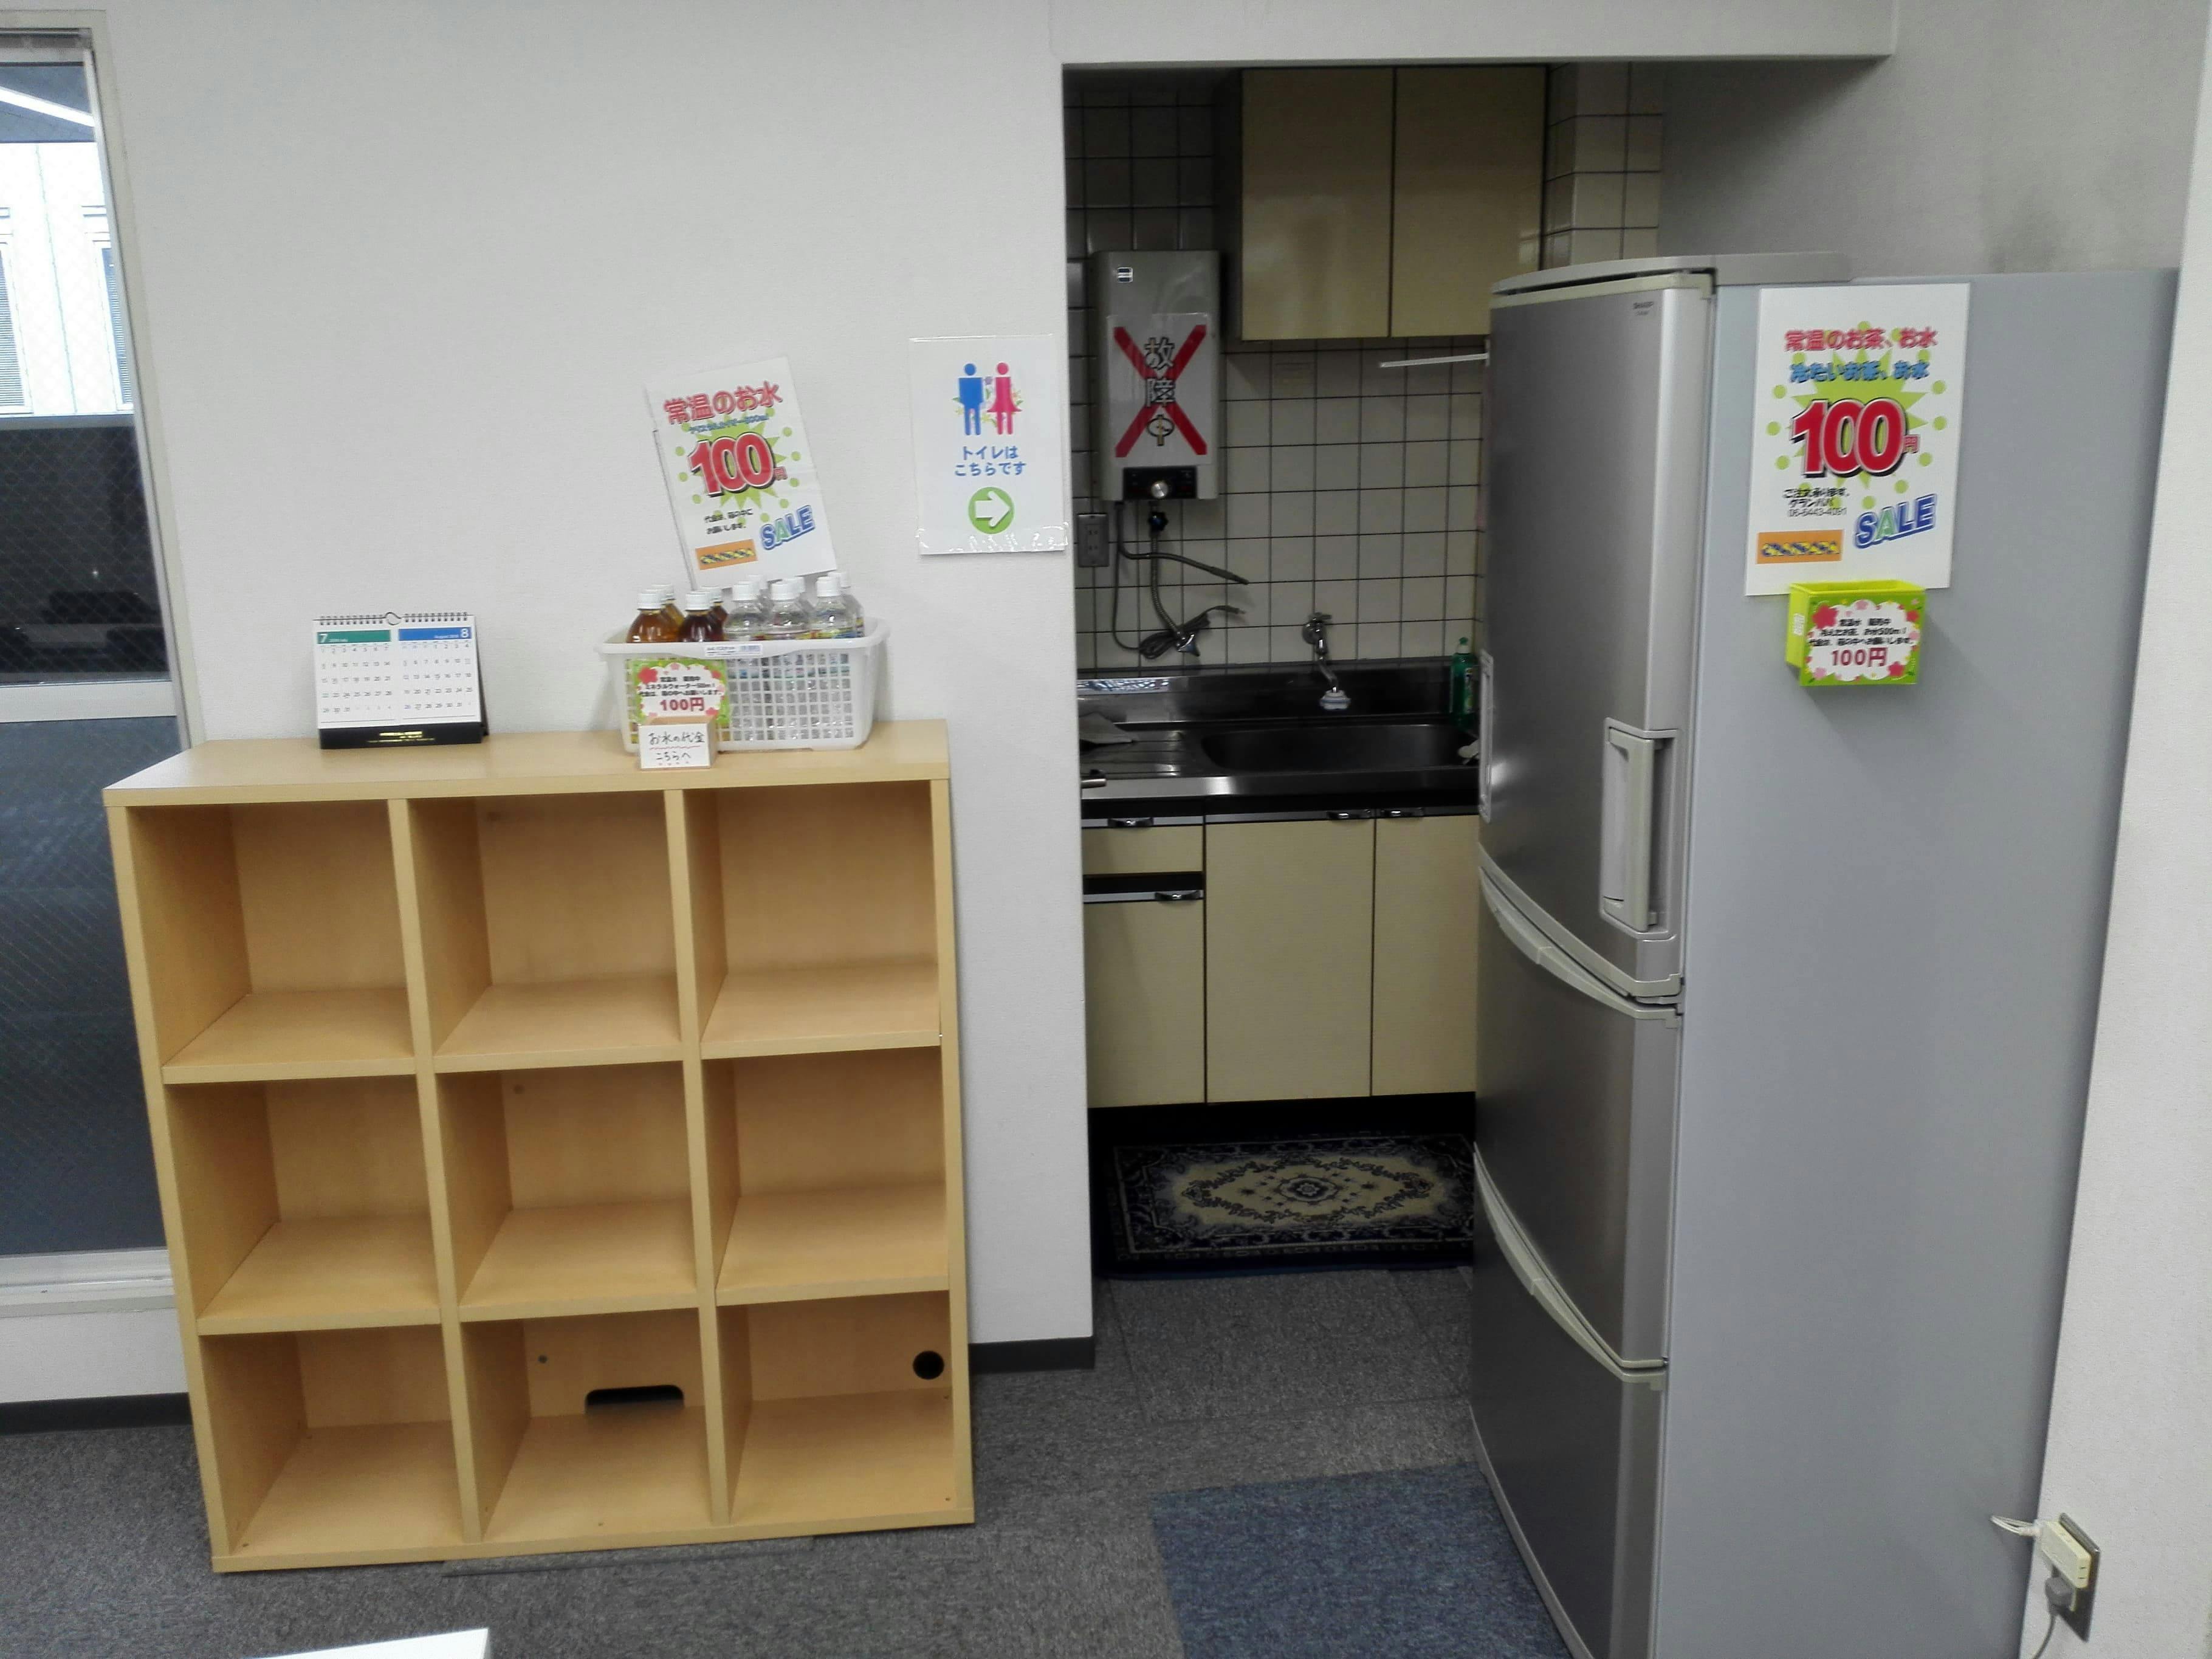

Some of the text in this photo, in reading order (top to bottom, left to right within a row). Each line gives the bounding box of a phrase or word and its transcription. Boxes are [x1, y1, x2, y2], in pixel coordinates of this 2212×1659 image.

[1784, 327, 1938, 352] 常温のお茶、お水
[1144, 336, 1175, 446] 故障中
[664, 380, 783, 424] 常温のお水
[1790, 397, 1921, 478] 100円
[962, 446, 1018, 460] トイレは
[687, 432, 789, 497] 100円
[955, 461, 1026, 476] こちらです
[760, 505, 816, 551] SALE
[1854, 493, 1937, 549] SALE
[320, 633, 328, 643] 7
[460, 628, 469, 638] 8
[1830, 647, 1889, 667] 100円
[659, 697, 705, 712] 100円
[648, 730, 705, 745] お水の代金
[656, 749, 692, 761] こちらへ
